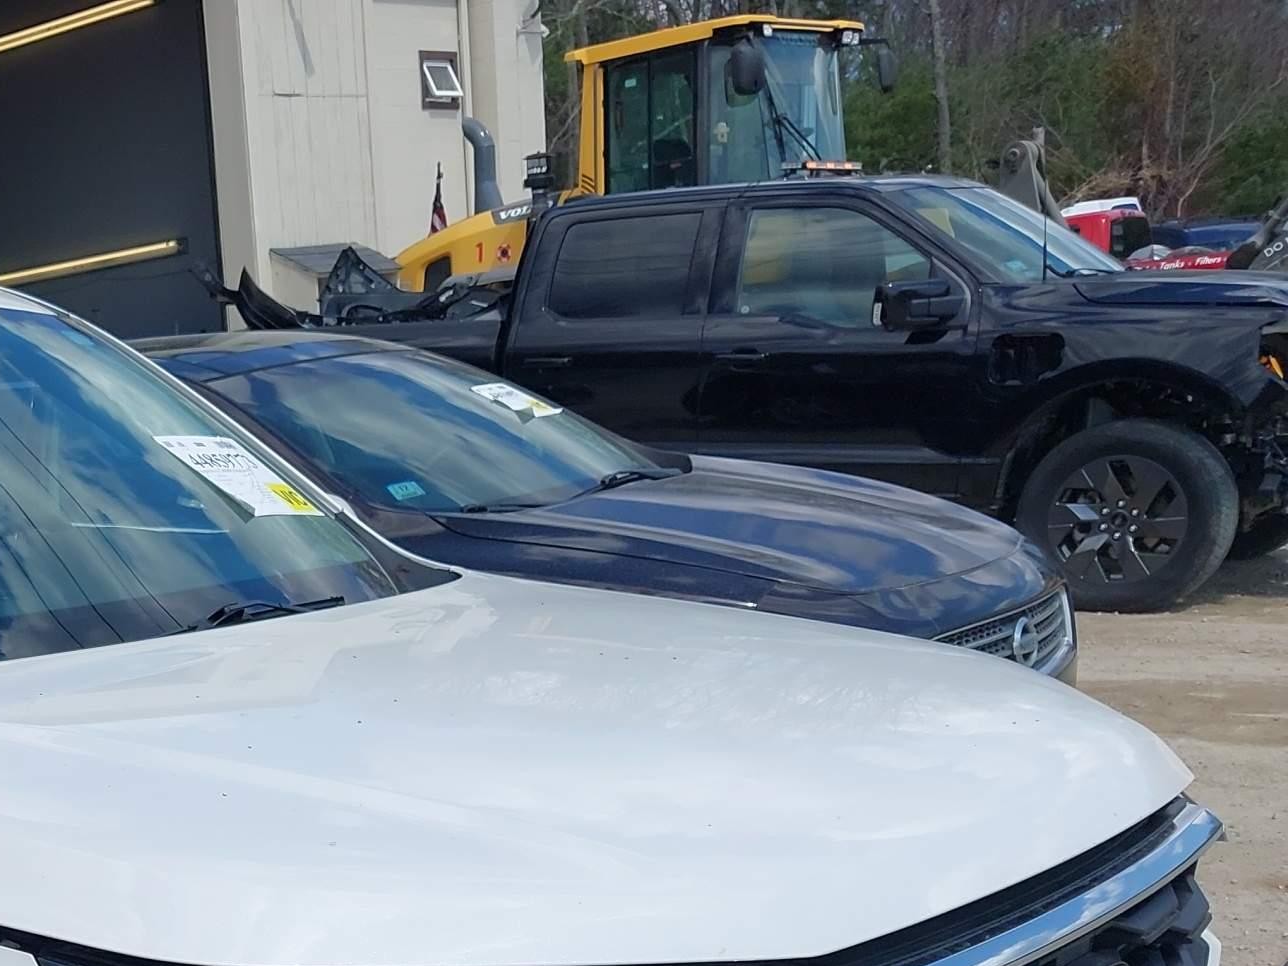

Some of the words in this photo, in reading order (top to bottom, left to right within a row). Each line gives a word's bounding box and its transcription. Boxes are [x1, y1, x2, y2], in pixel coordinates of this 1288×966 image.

[1263, 241, 1284, 257] DO
[1160, 260, 1185, 270] Tanks
[1194, 256, 1222, 266] Filters
